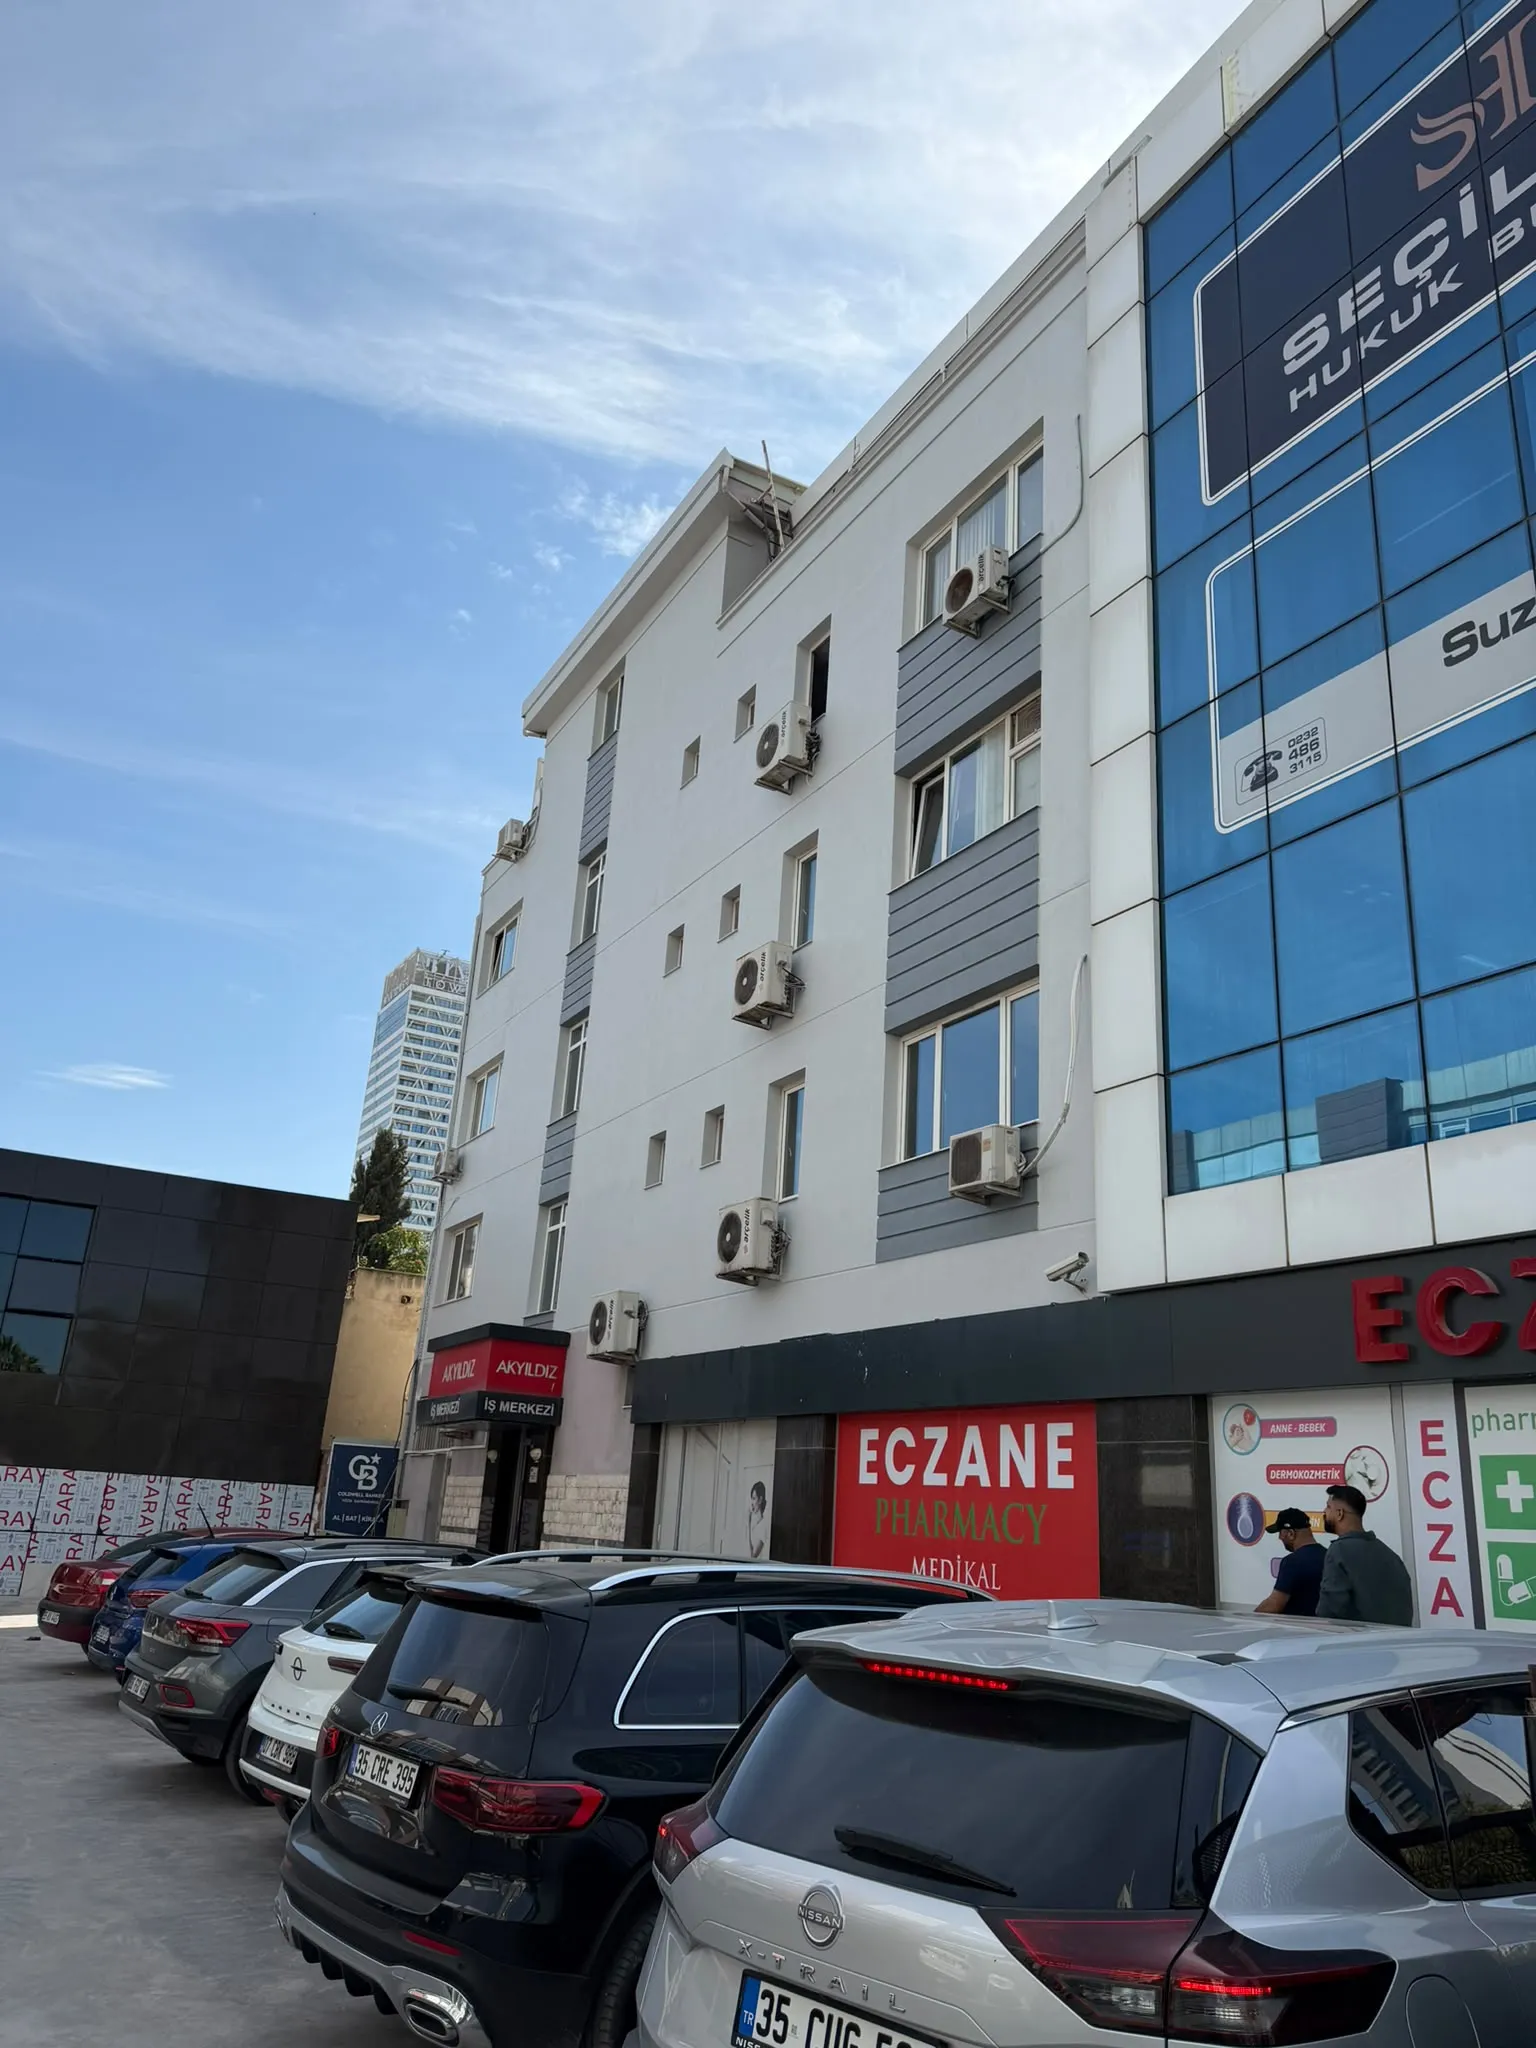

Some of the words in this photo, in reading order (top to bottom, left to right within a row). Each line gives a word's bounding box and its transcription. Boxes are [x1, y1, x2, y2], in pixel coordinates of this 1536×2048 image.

[1289, 263, 1464, 413] HUKUK
[1288, 726, 1319, 749] 0232
[1289, 737, 1320, 760] 486
[1290, 750, 1322, 774] 3115
[442, 1359, 476, 1383] AKYILDIZ
[496, 1360, 558, 1380] AKYILDIZ
[484, 1397, 496, 1413] İŞ
[499, 1400, 555, 1417] MERKEZİ
[1270, 1424, 1295, 1433] ANNE
[1299, 1422, 1326, 1433] BEBEK
[858, 1422, 1075, 1489] ECZANE
[1270, 1468, 1340, 1480] DERMOKOZMETİK
[875, 1498, 1047, 1545] PHARMACY
[911, 1555, 1001, 1590] MEDİKAL
[355, 1749, 370, 1776] 35
[370, 1754, 393, 1786] CRE
[392, 1763, 416, 1795] 395
[799, 1905, 842, 1929] NISSAN
[739, 1939, 905, 2013] X-TRAIL
[743, 2009, 755, 2027] TR
[756, 1989, 790, 2044] 35
